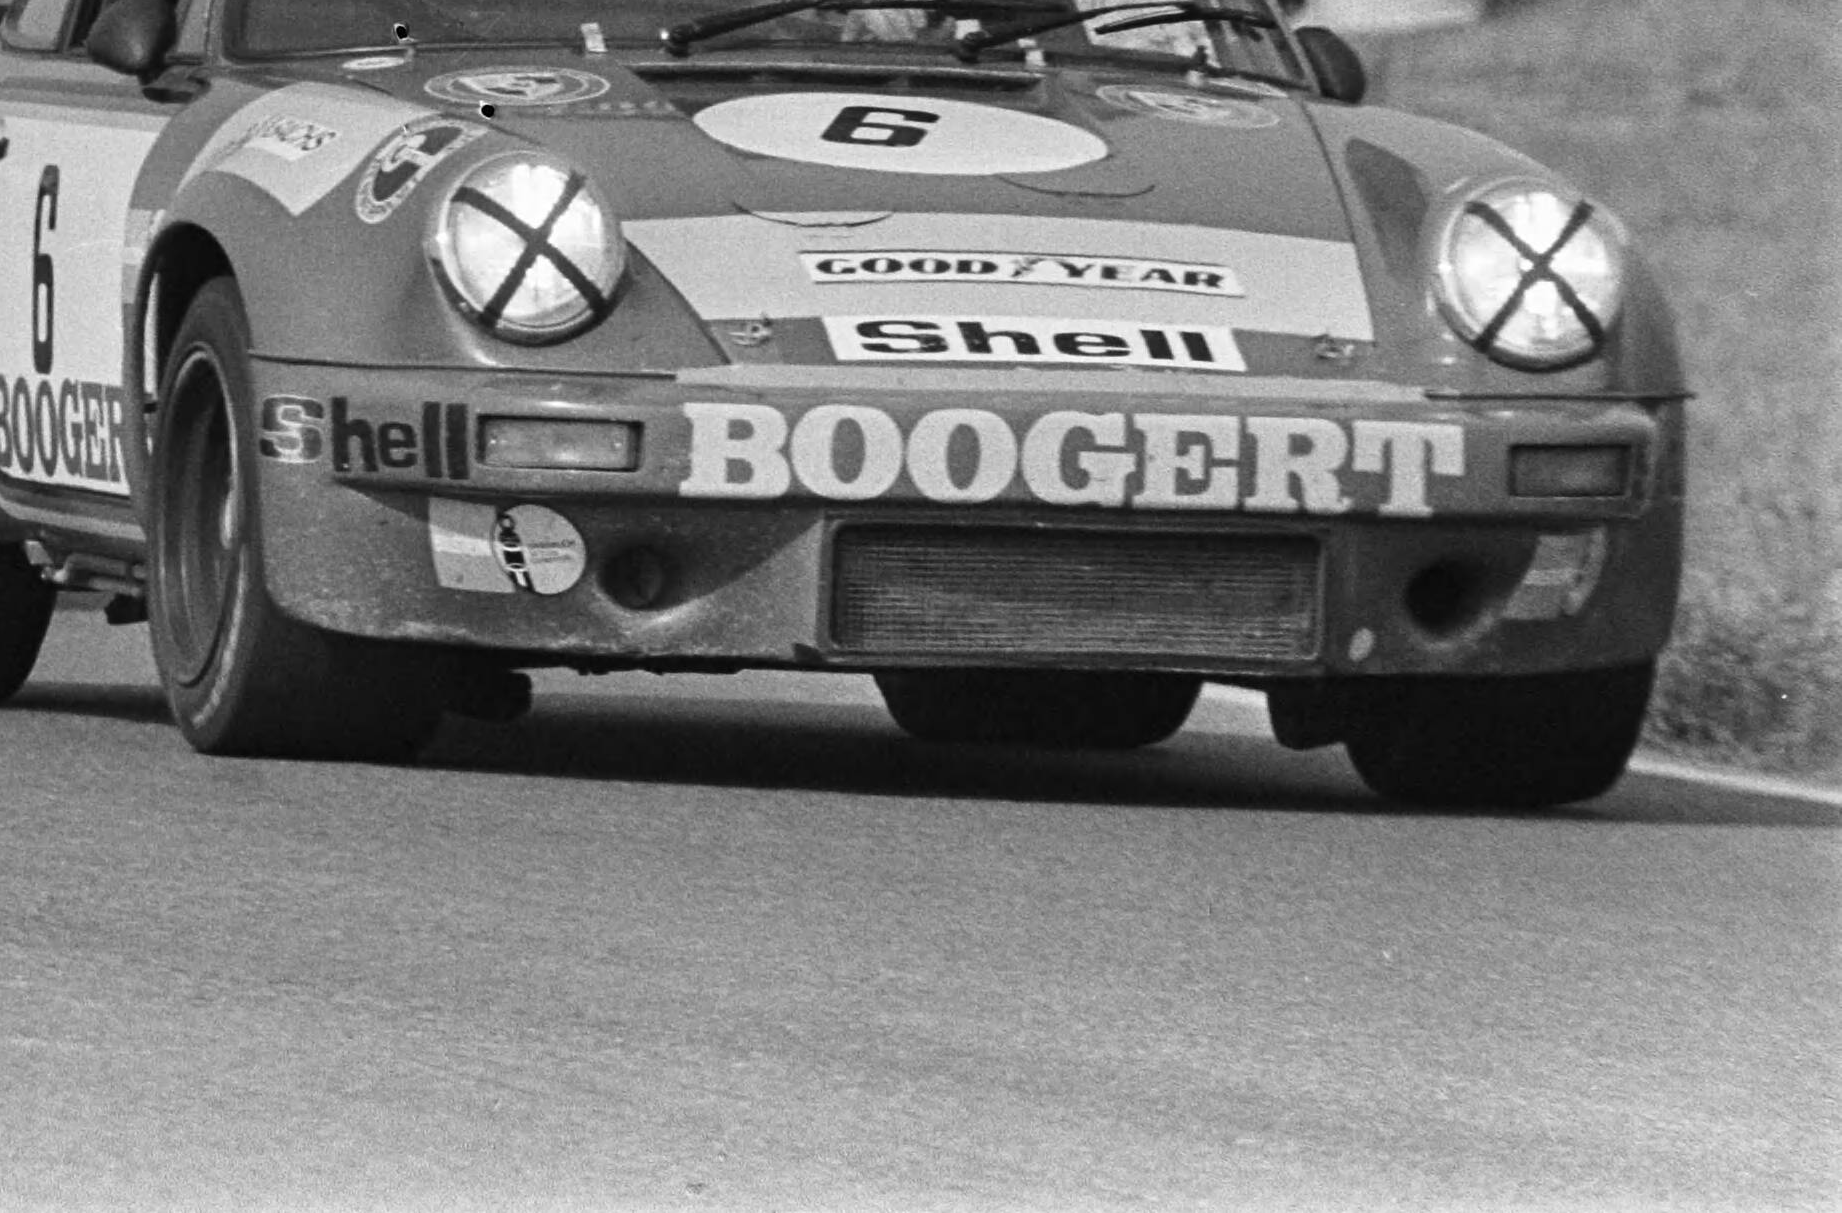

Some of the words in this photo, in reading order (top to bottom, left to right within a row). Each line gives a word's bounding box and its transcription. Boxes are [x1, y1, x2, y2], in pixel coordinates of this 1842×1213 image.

[820, 105, 939, 148] 6
[32, 164, 59, 374] 6
[858, 320, 1216, 363] Shell
[261, 394, 470, 480] Shell
[679, 401, 1464, 516] BOOGERT
